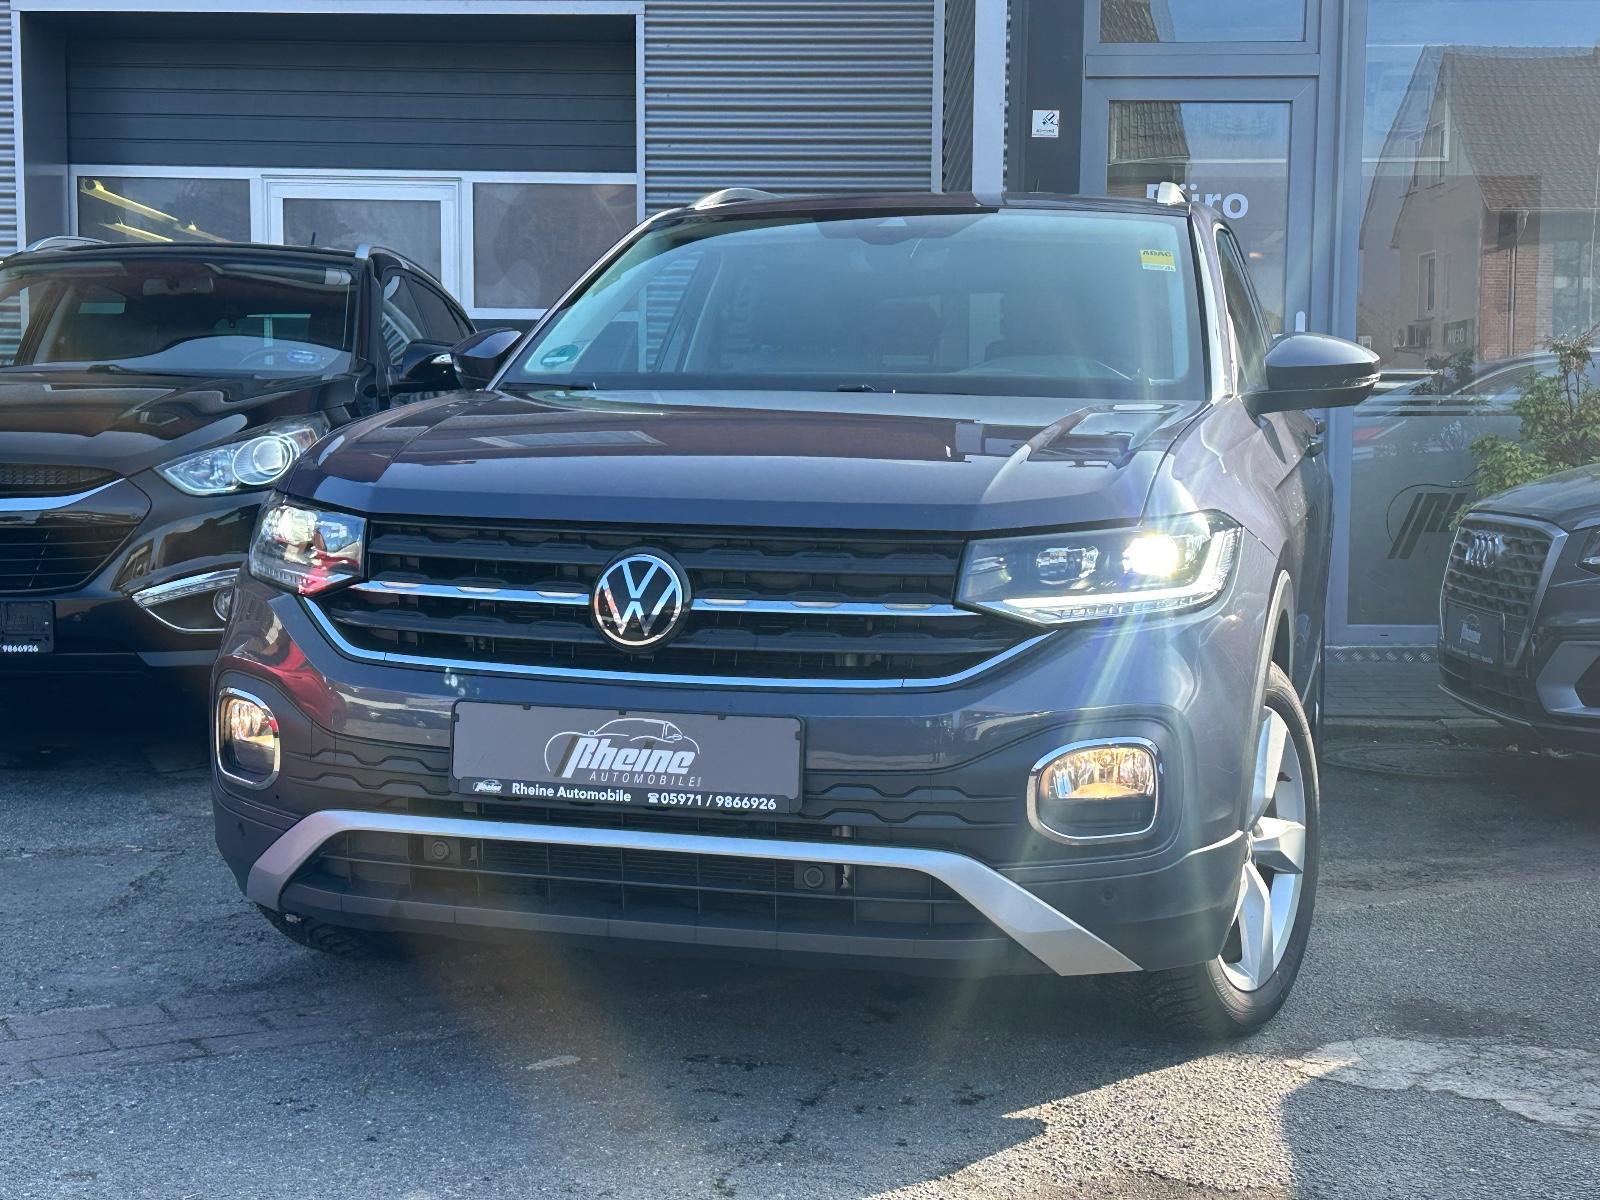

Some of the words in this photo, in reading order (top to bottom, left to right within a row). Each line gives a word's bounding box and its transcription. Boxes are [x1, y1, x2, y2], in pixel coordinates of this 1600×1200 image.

[1146, 183, 1249, 219] ro
[561, 737, 696, 778] Rheine
[511, 782, 555, 797] Rheine
[556, 786, 632, 802] Automobile
[660, 792, 702, 806] 05971
[715, 795, 777, 810] 9866926
